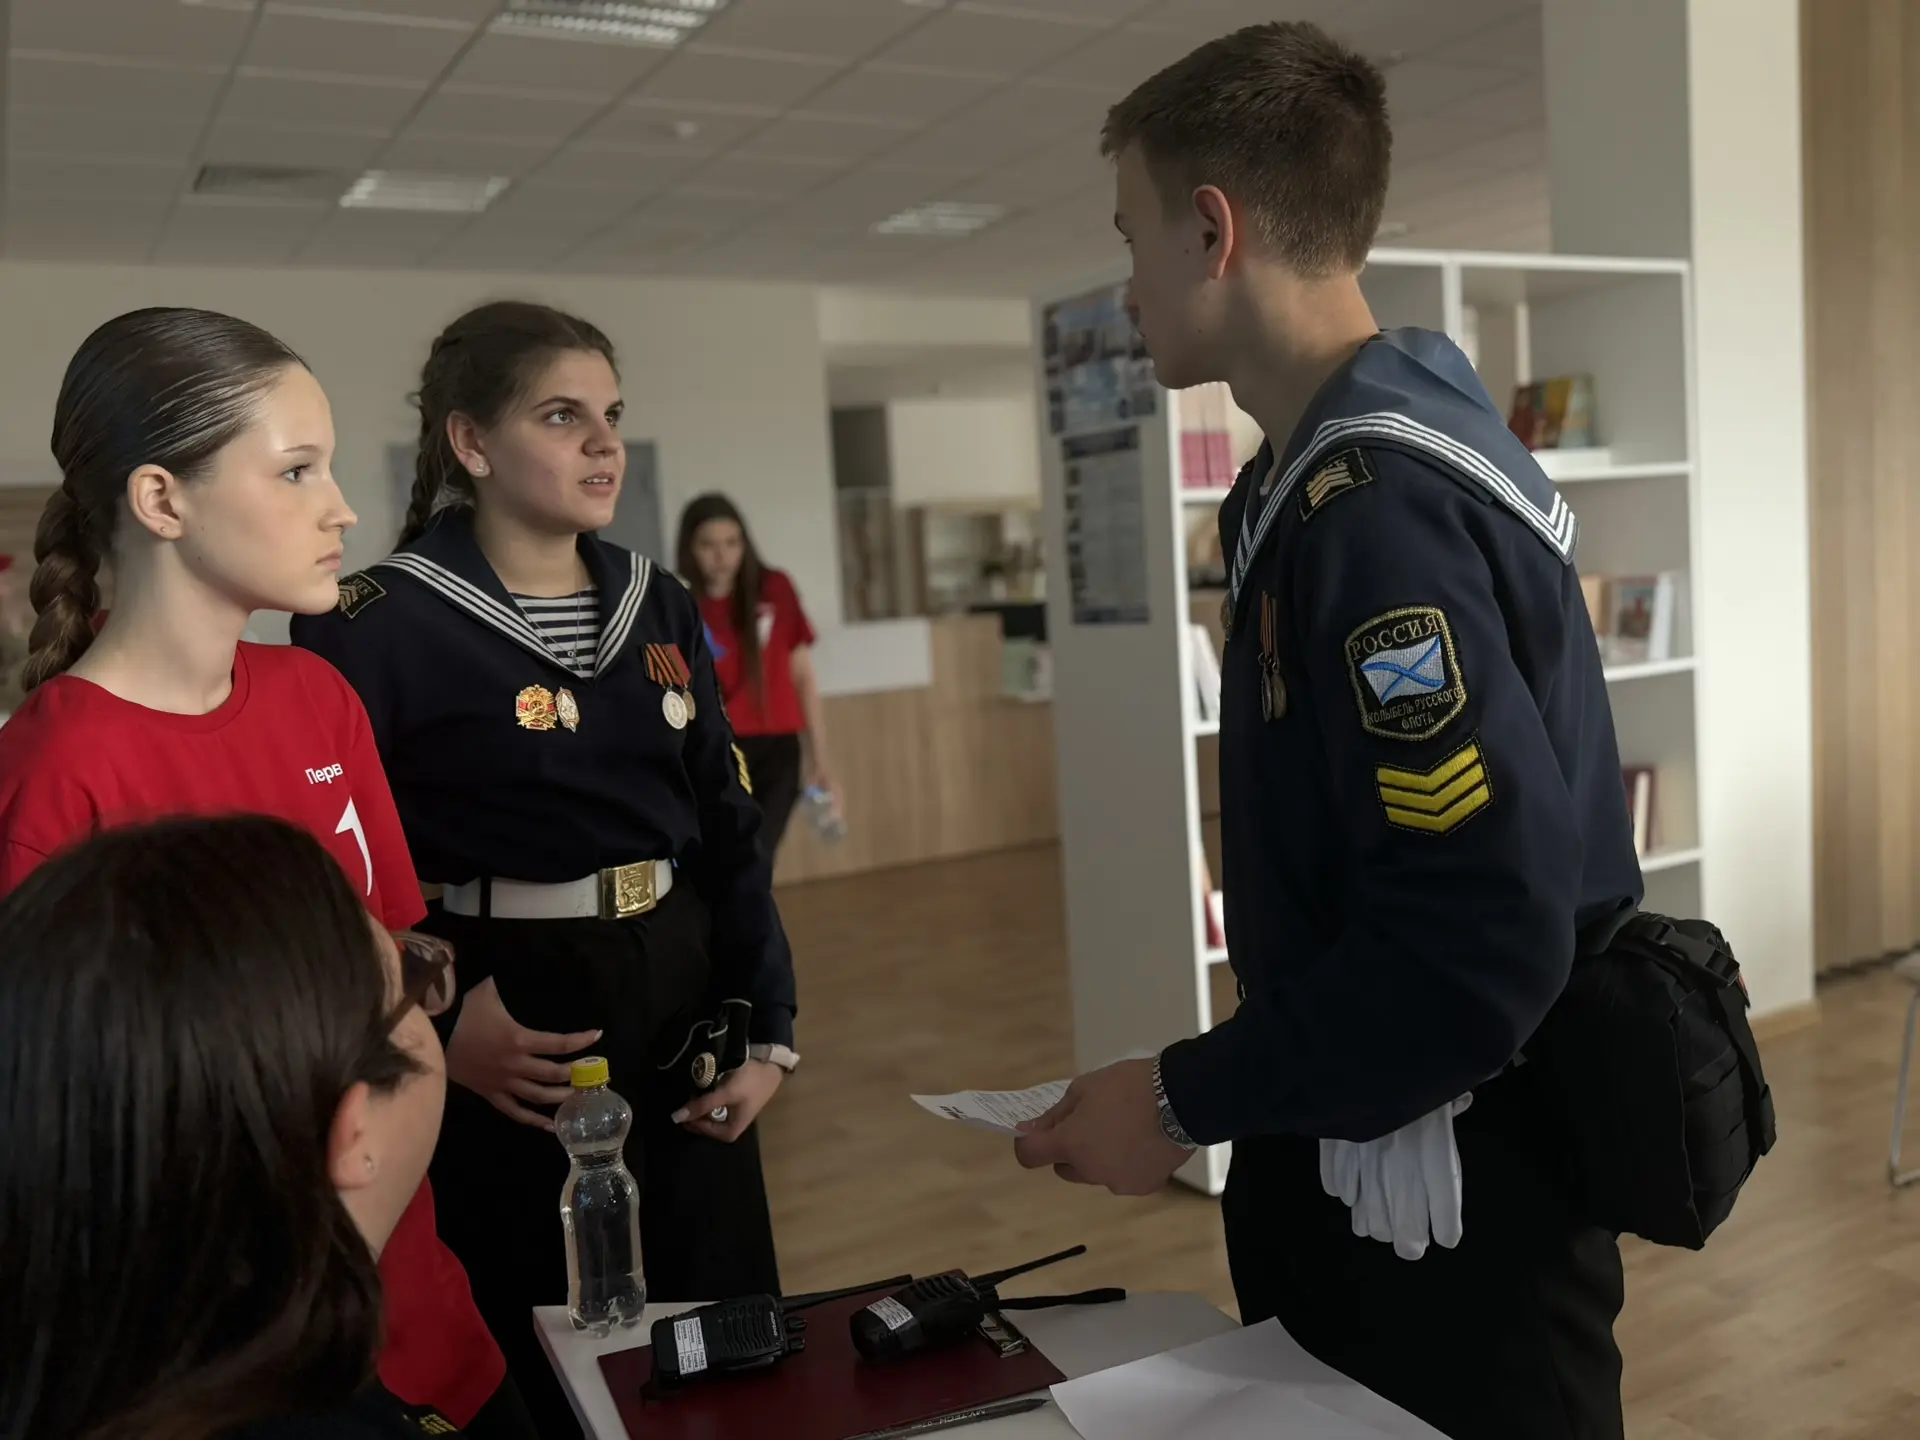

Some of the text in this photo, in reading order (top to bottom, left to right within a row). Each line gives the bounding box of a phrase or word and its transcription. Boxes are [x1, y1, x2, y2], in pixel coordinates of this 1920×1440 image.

[1351, 615, 1442, 660] РОССИЯ
[1367, 688, 1462, 725] КОЛЫБЕЛЬ РУССКОГО
[1401, 712, 1435, 731] ФЛОТА
